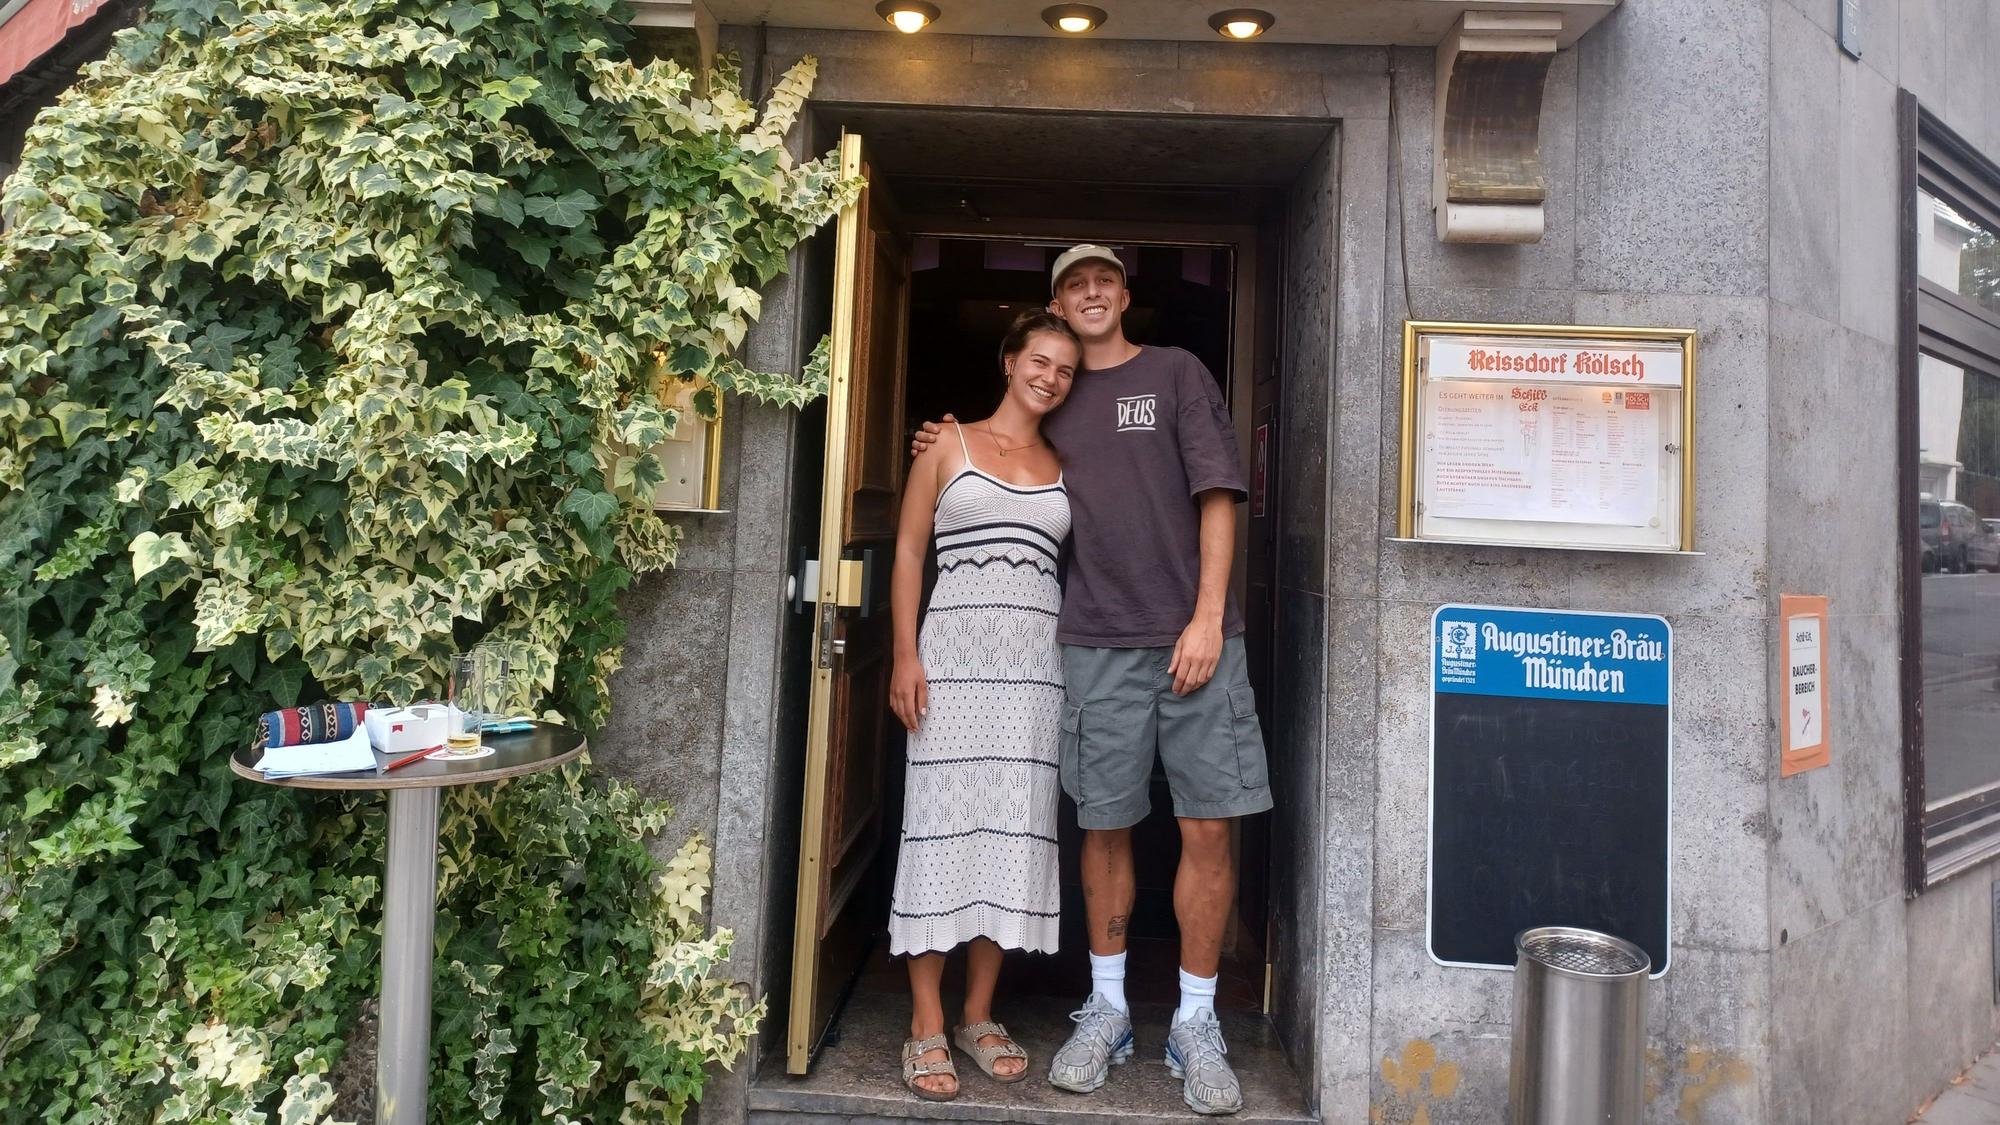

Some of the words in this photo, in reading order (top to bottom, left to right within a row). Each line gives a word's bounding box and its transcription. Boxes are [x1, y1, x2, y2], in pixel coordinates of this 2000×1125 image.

[1468, 349, 1567, 374] Reissdorf
[1573, 351, 1645, 381] Kölsch
[1116, 399, 1156, 428] DEUS
[1522, 656, 1625, 693] München
[1795, 681, 1815, 695] BEREICH
